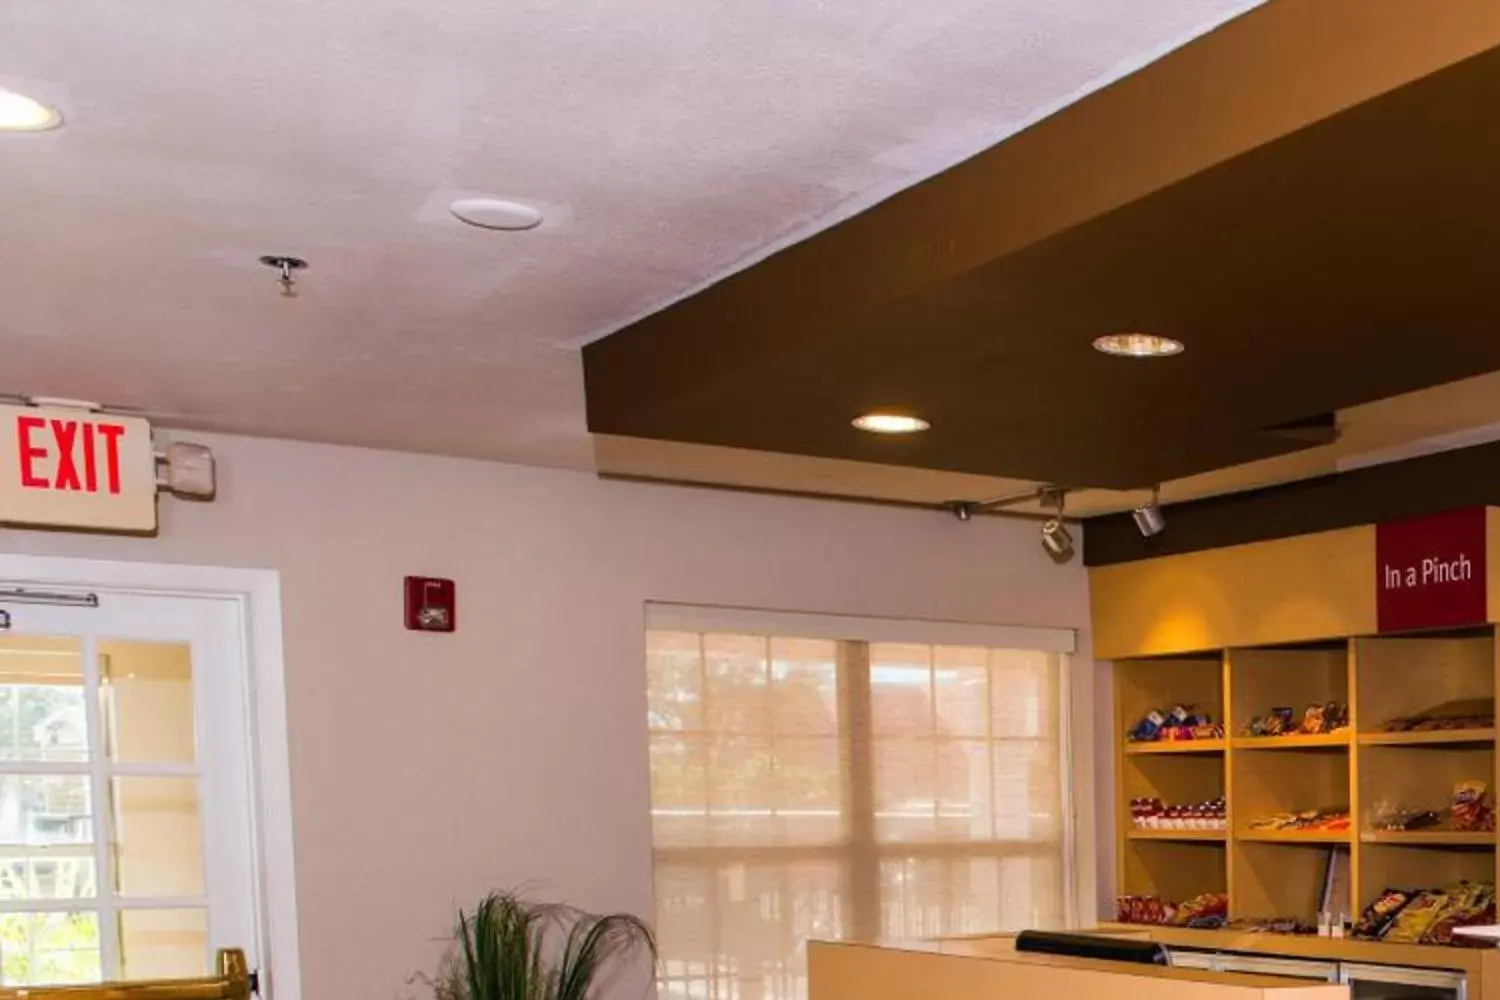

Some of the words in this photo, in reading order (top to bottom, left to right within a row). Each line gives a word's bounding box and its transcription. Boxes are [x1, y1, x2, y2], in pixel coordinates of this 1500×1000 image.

[17, 416, 125, 495] EXIT
[1385, 564, 1401, 590] In
[1405, 566, 1417, 588] a
[1422, 552, 1472, 585] Pinch
